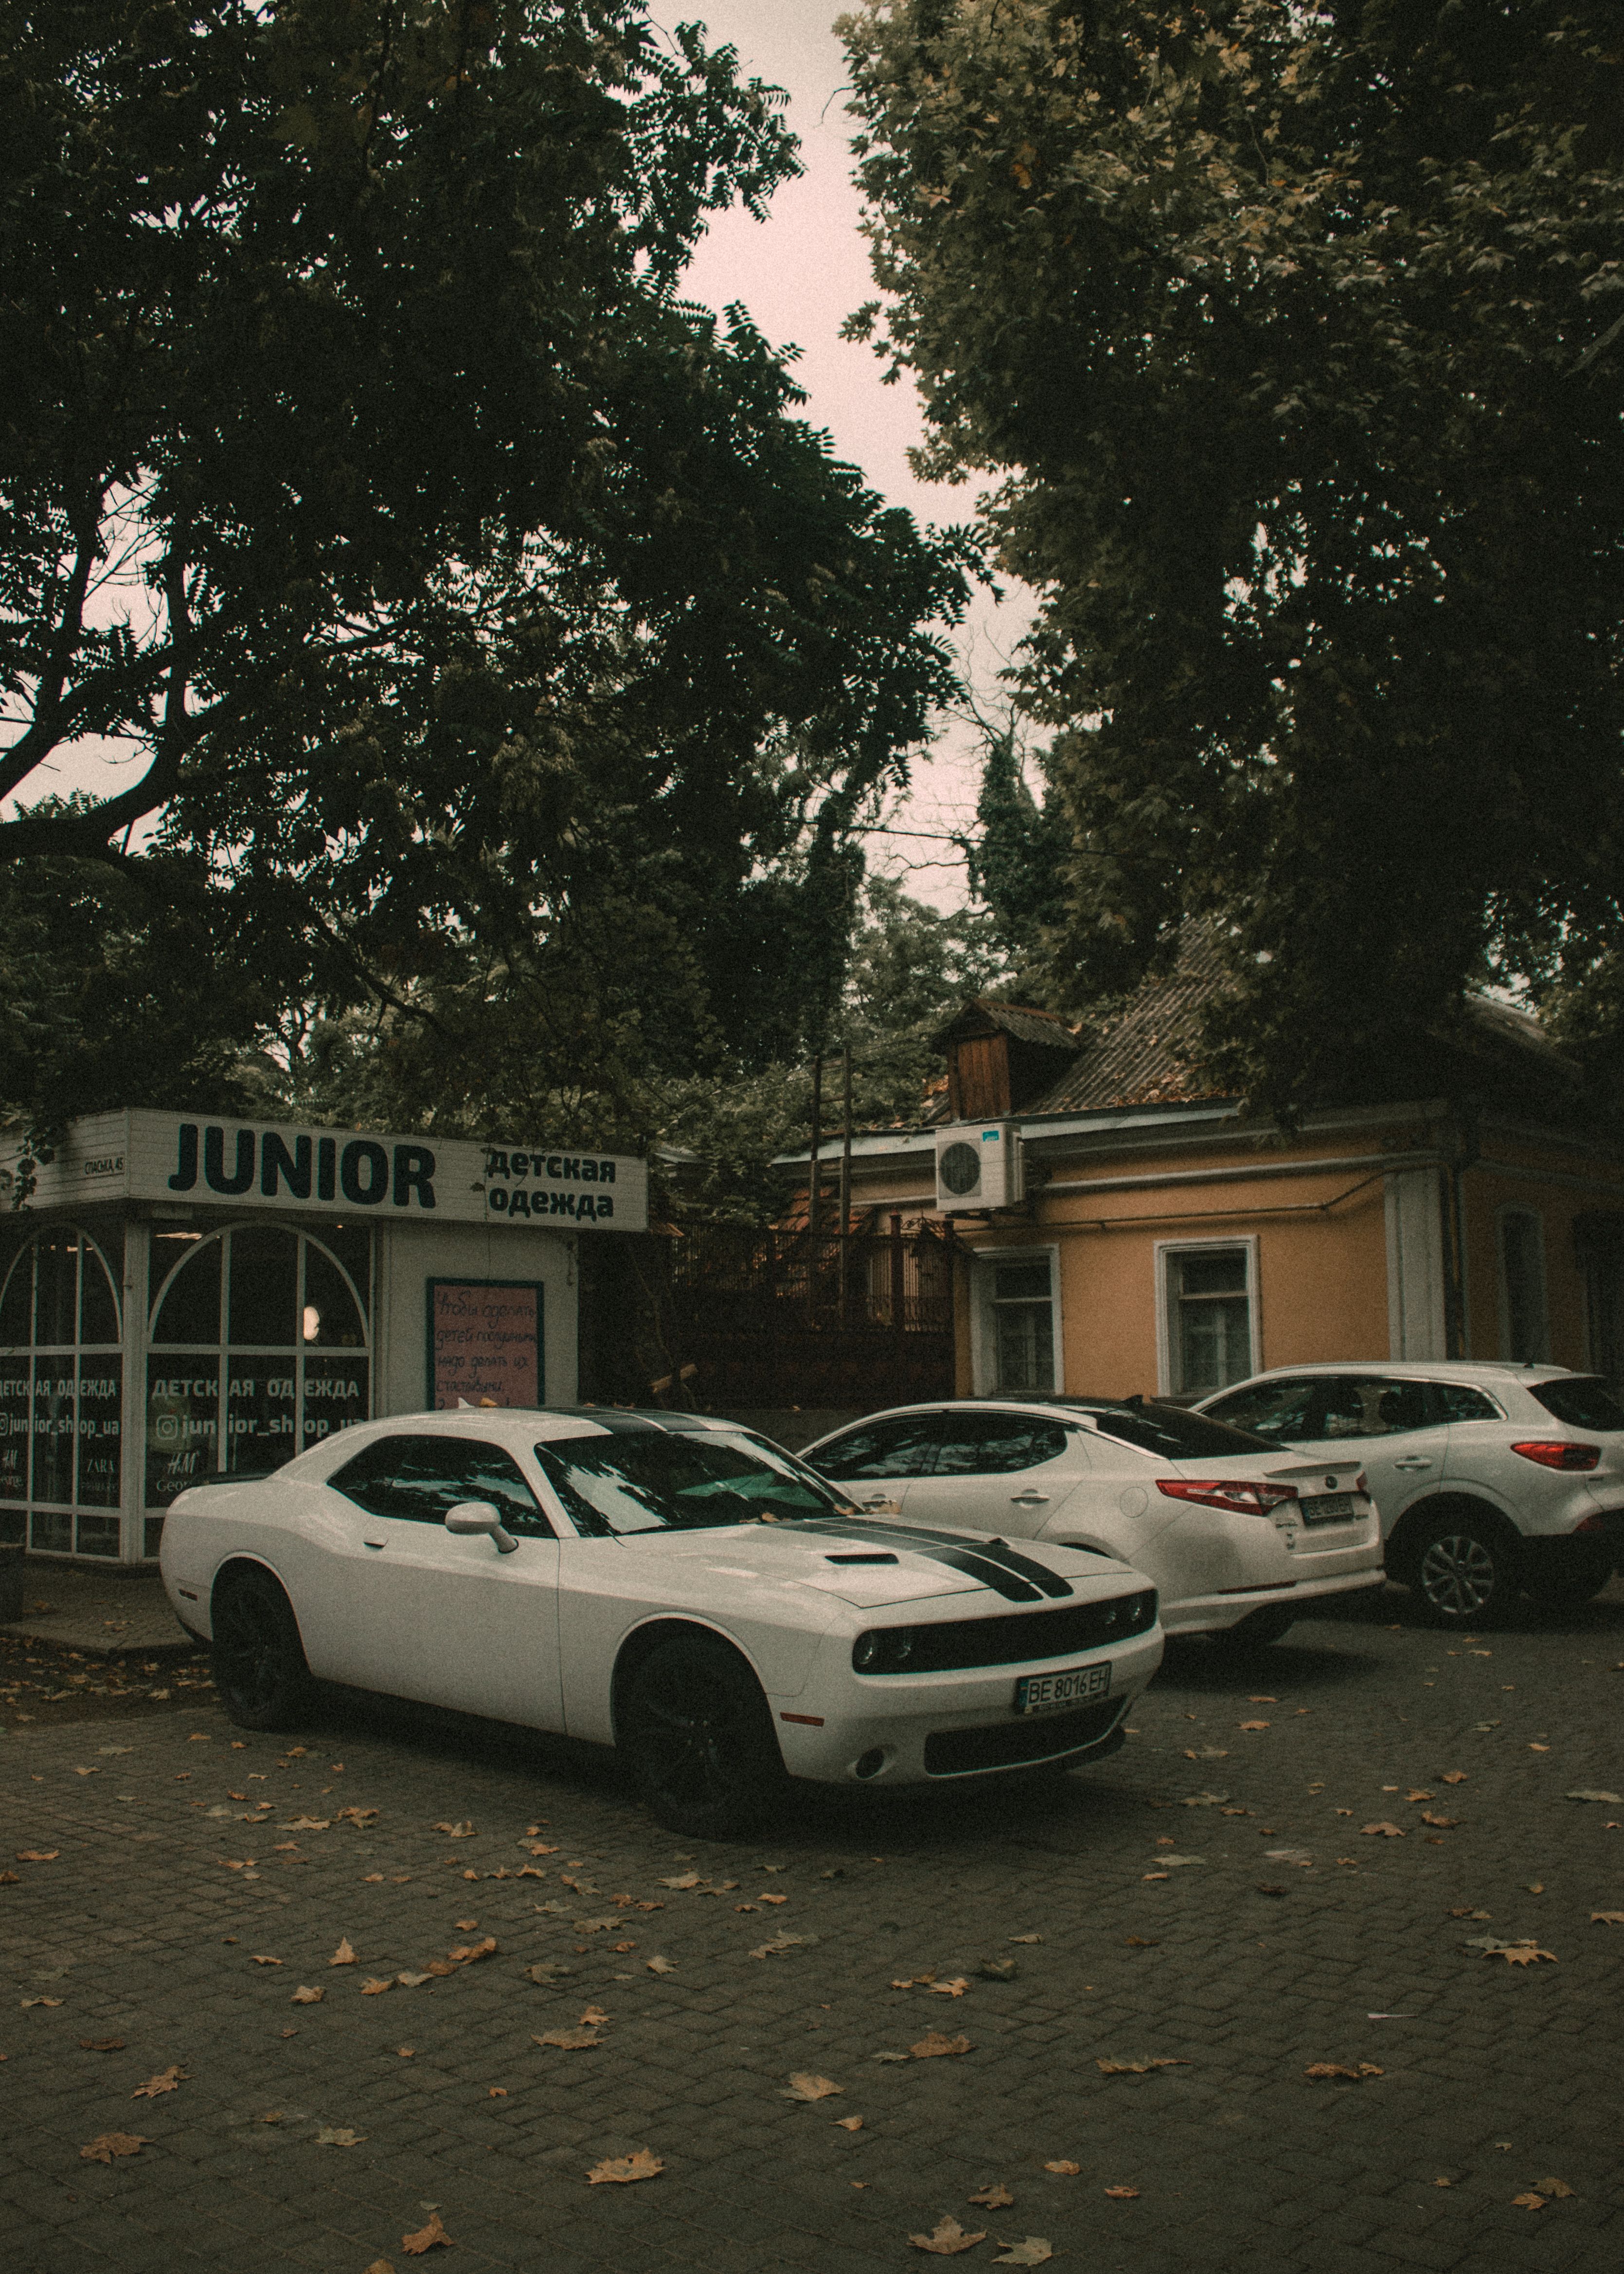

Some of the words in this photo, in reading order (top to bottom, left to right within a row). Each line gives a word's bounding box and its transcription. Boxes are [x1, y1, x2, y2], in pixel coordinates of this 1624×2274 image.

[168, 1123, 435, 1208] JUNIOR
[485, 1151, 616, 1183] детская
[489, 1187, 613, 1222] одежда
[58, 1379, 116, 1399] ОДЕЖДА
[152, 1379, 254, 1399] ДЕТСКАЯ
[267, 1379, 359, 1399] ОДЕЖДА
[1029, 1680, 1052, 1702] BE
[1055, 1674, 1087, 1698] 8016
[1089, 1669, 1108, 1691] EH
